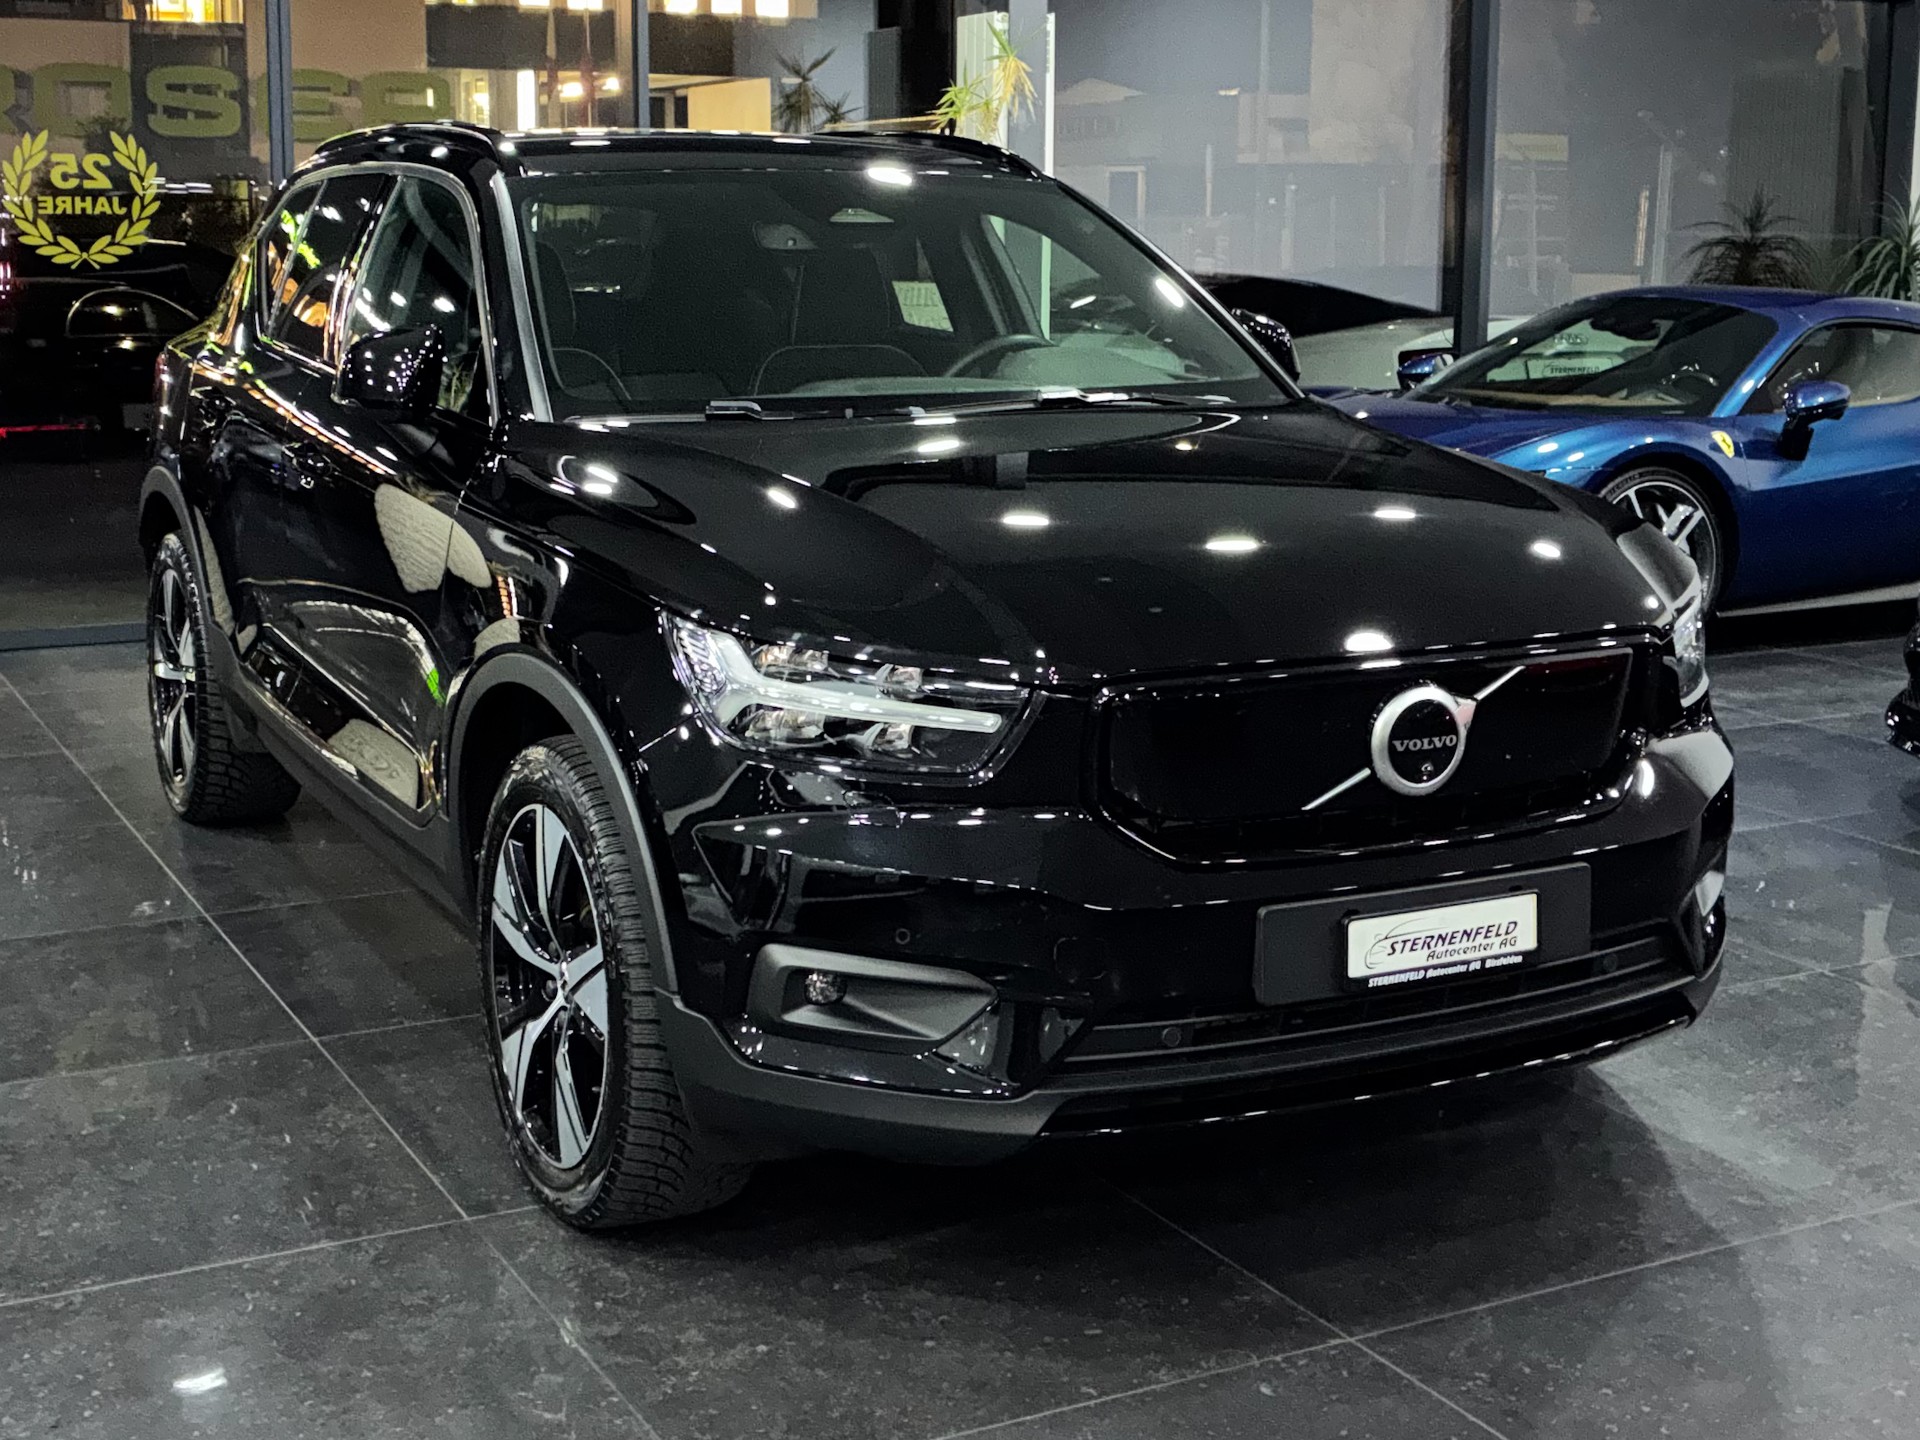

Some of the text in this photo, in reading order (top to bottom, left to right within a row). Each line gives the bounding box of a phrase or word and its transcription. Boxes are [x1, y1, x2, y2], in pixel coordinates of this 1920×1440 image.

[1392, 734, 1457, 752] VOLVO
[1387, 921, 1518, 956] STERNENFELD
[1426, 936, 1518, 962] Autocenter AG
[1368, 969, 1425, 987] STERNENFELD
[1426, 962, 1468, 979] Autocenter
[1468, 960, 1482, 972] AG
